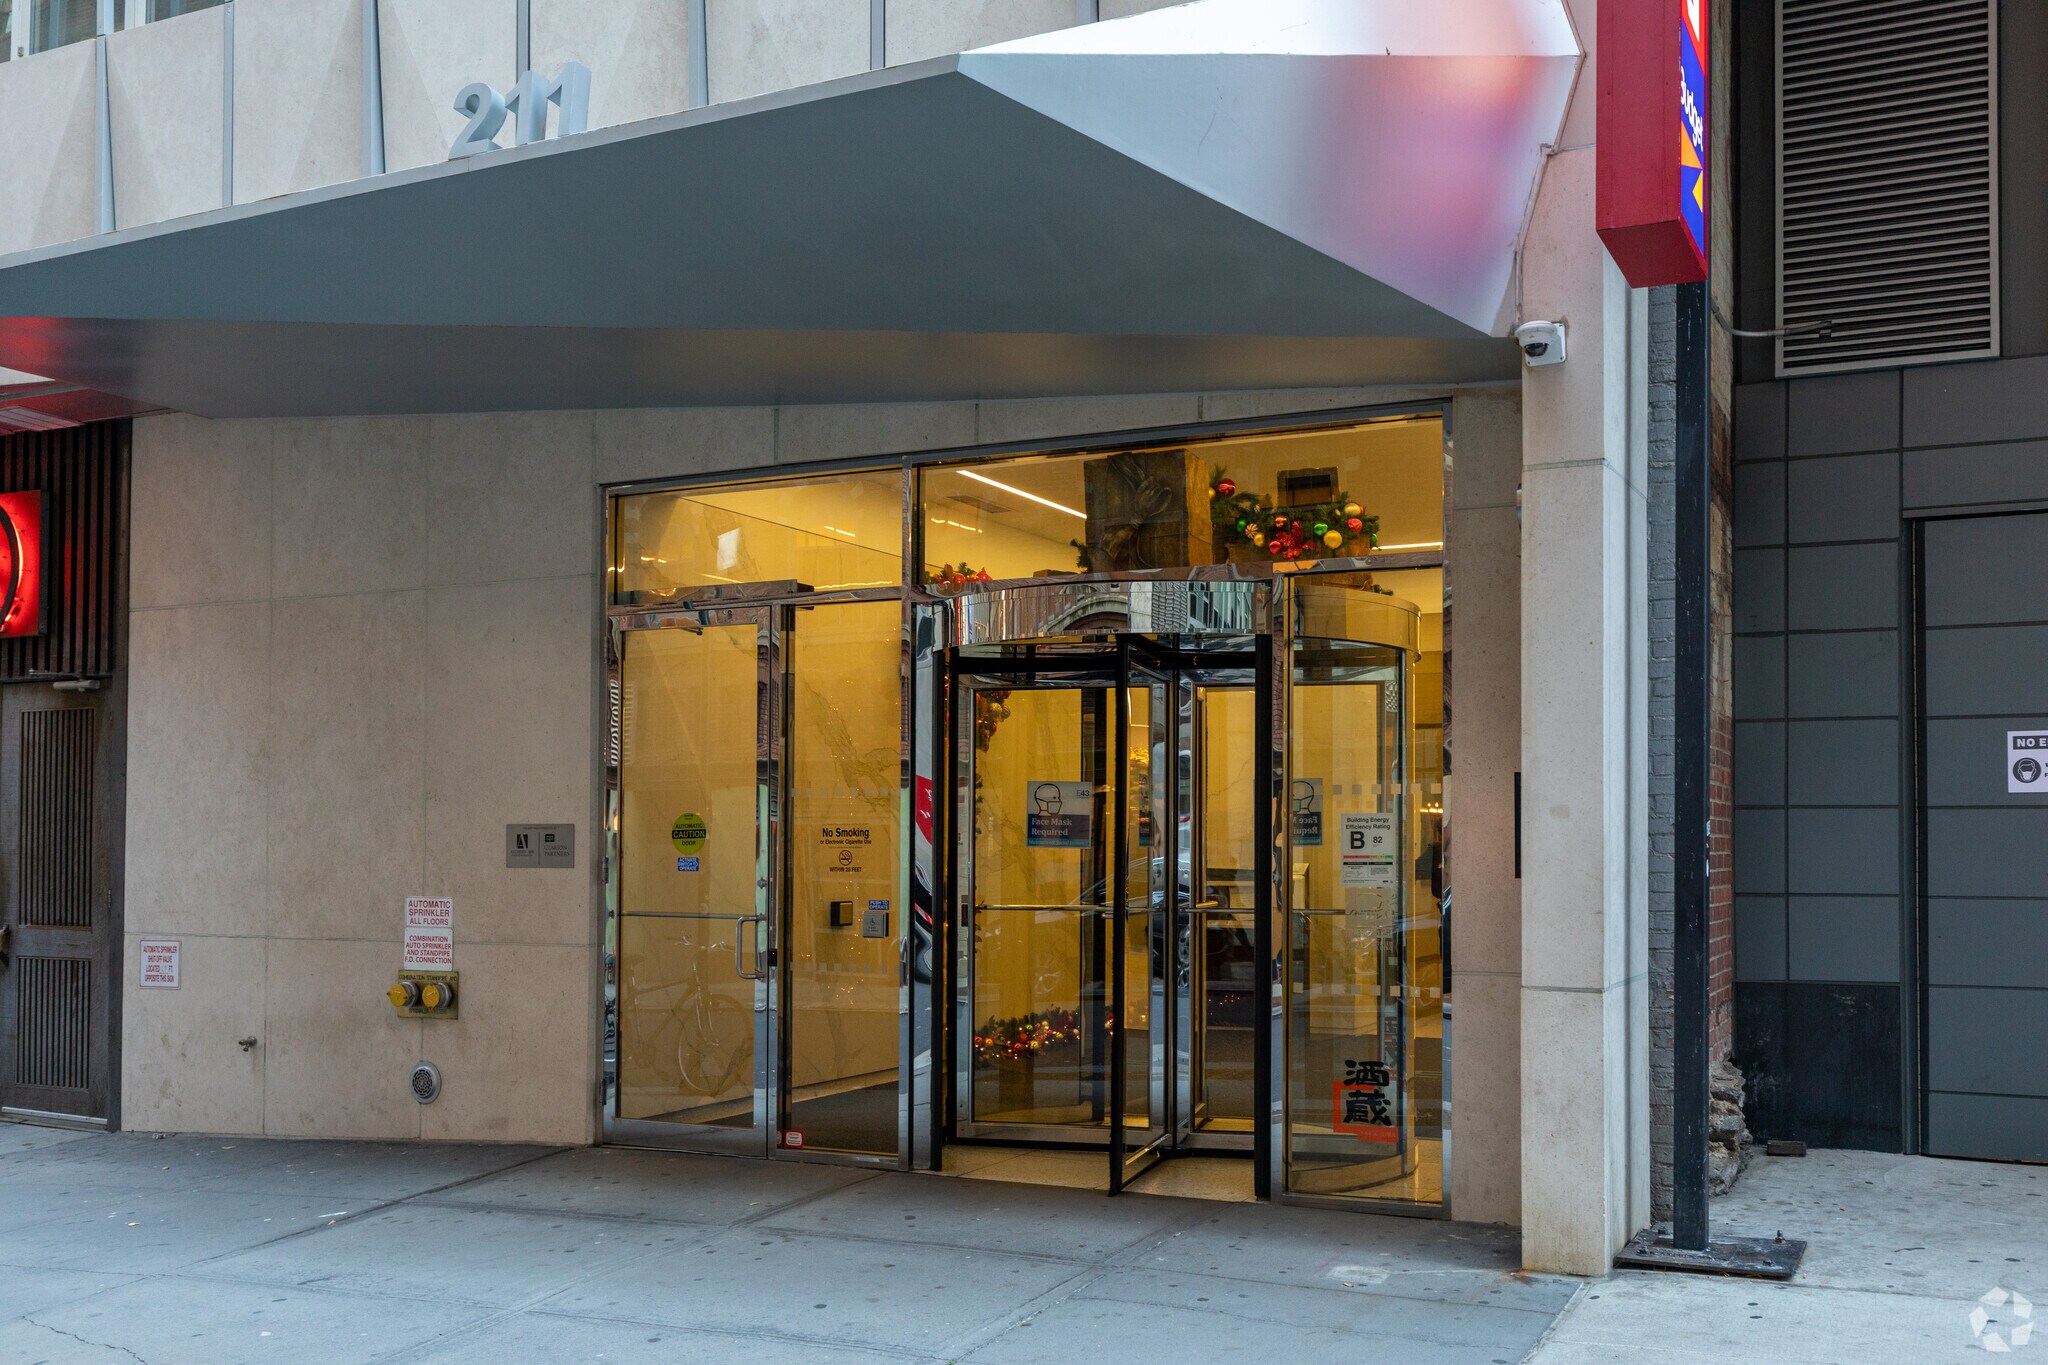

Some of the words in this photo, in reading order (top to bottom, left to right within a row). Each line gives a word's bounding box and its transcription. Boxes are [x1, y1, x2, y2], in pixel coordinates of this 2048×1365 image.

[448, 61, 592, 161] 211
[2017, 738, 2035, 747] NO
[1032, 818, 1050, 826] Face
[1051, 818, 1072, 826] Mask
[673, 830, 705, 838] CAUTION
[822, 828, 833, 837] No
[835, 827, 869, 839] Smoking
[1031, 828, 1068, 837] Required
[1350, 831, 1365, 849] B
[408, 900, 451, 909] AUTOMATIC
[408, 908, 450, 917] SPRINKLER
[423, 918, 449, 926] FLOORS
[415, 956, 452, 964] CONNECTION
